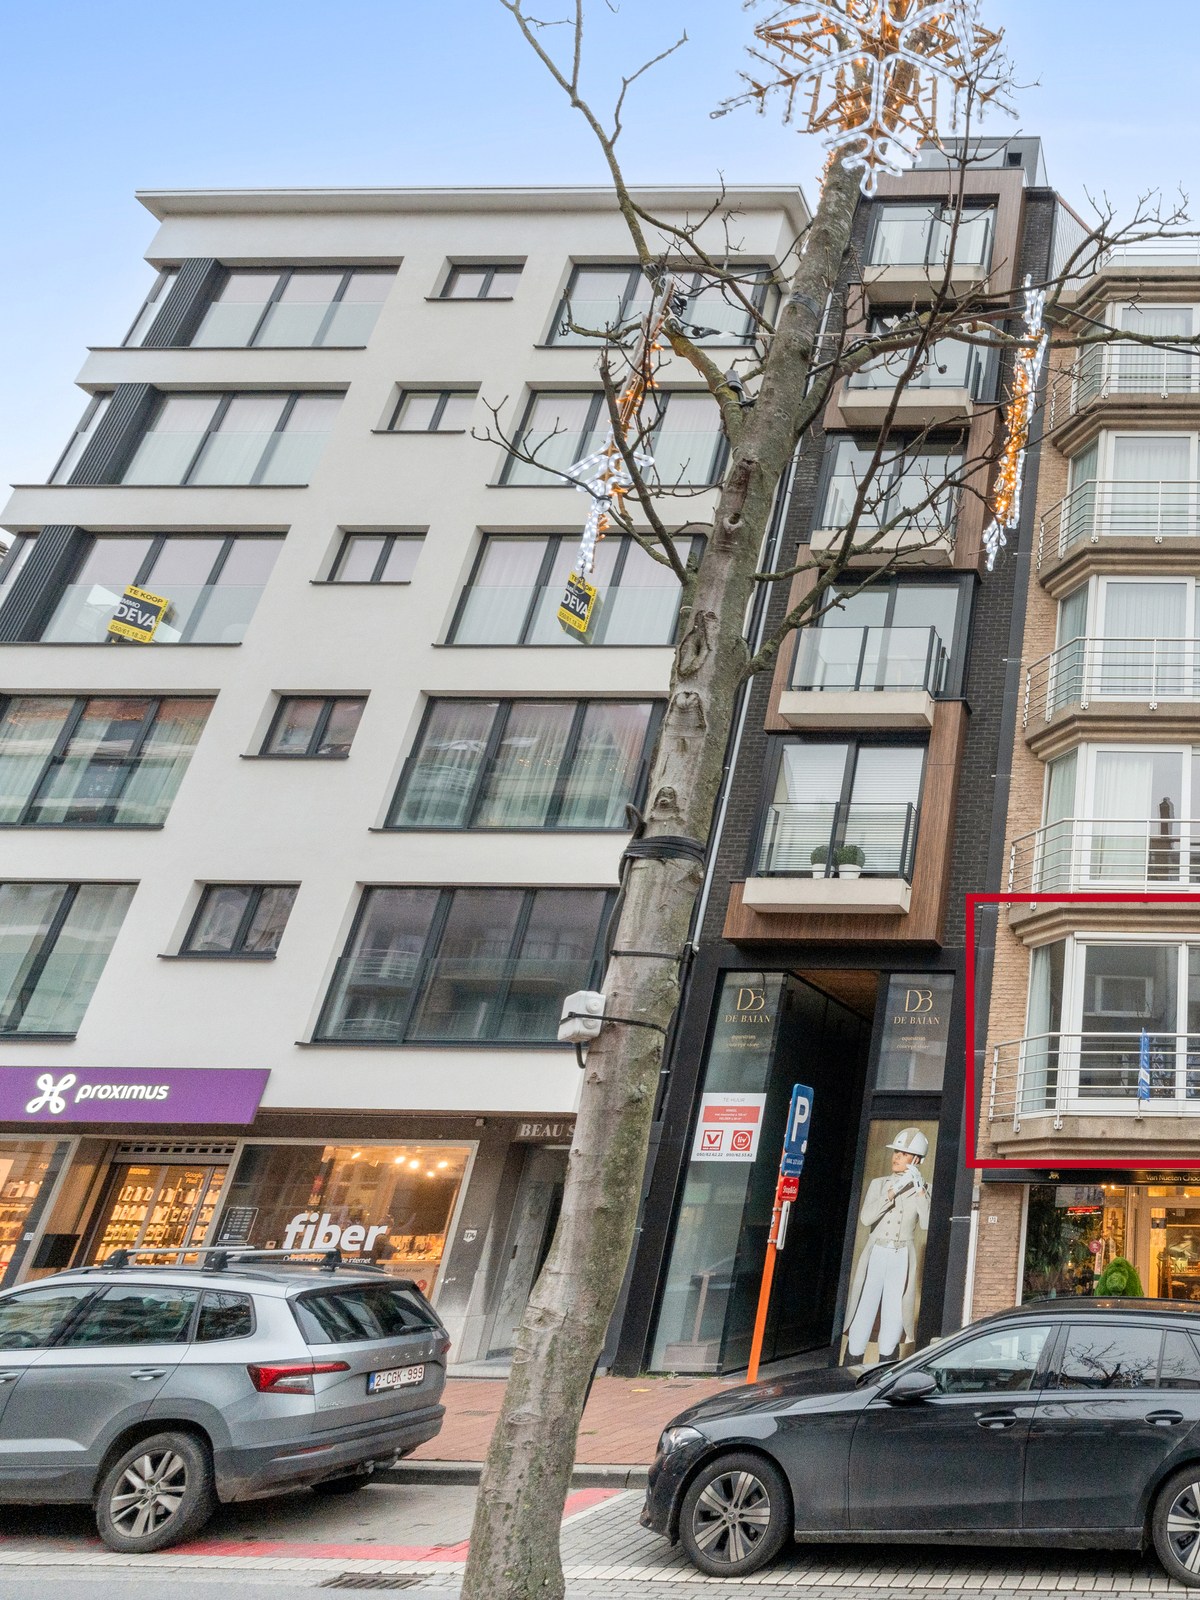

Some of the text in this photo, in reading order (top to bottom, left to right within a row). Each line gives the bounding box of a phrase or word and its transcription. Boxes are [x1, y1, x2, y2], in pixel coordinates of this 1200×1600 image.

[129, 587, 164, 604] TE KOOP
[561, 589, 588, 617] DEVA
[115, 604, 157, 629] DEVA
[725, 1014, 738, 1023] DE
[893, 1016, 907, 1025] DE
[74, 1084, 170, 1104] proximus
[790, 1095, 810, 1143] P
[519, 1123, 563, 1138] BEAU
[281, 1212, 388, 1251] fiber
[375, 1366, 424, 1388] 2-CGK-999
